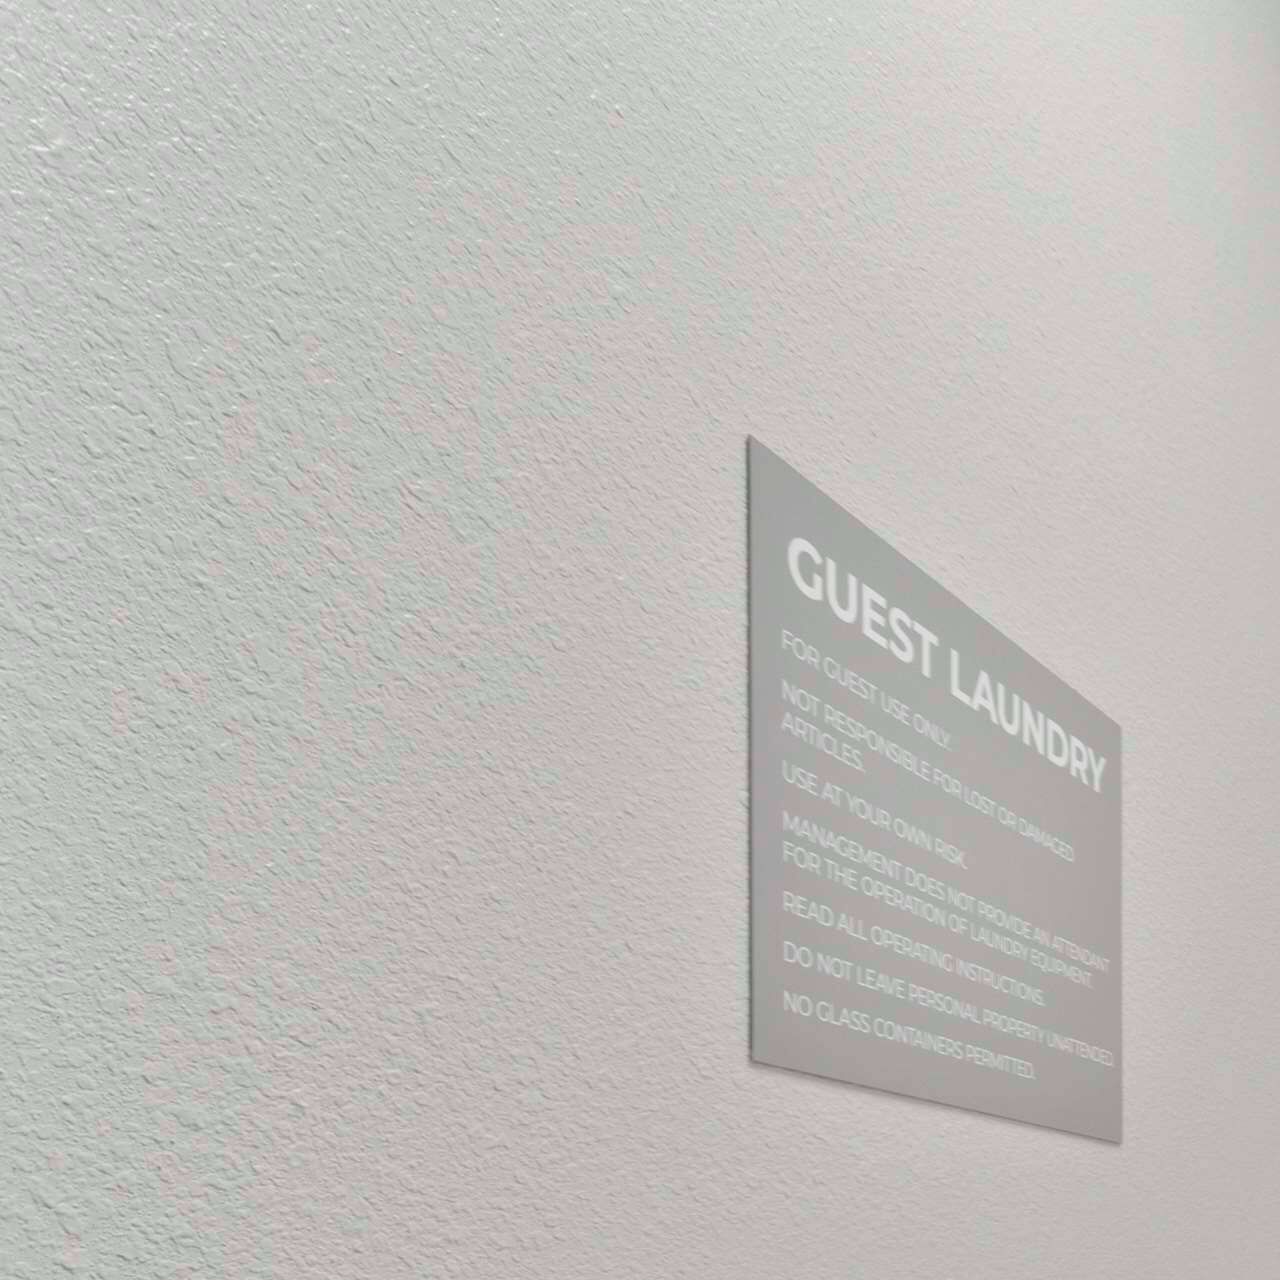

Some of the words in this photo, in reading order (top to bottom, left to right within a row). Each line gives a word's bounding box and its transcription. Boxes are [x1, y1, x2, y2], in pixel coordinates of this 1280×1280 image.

[780, 627, 820, 671] FOR
[822, 654, 879, 707] GUEST
[879, 690, 912, 727] USE
[786, 537, 939, 679] GUEST
[949, 647, 1107, 794] LAUNDRY
[780, 676, 822, 720] NOT
[823, 702, 931, 782] RESPONSIBLE
[932, 766, 963, 800] FOR
[963, 784, 996, 819] LOST
[998, 805, 1017, 831] OR
[781, 759, 818, 796] USE
[822, 779, 843, 808] AT
[842, 790, 892, 832] YOUR
[893, 816, 933, 852] OWN
[782, 809, 904, 882] MANAGEMENT
[905, 866, 945, 901] DOES
[947, 886, 975, 914] NOT
[977, 900, 1032, 940] PROVIDE
[1032, 925, 1050, 947] AN
[782, 840, 822, 876] FOR
[823, 858, 859, 891] THE
[860, 874, 945, 927] OPERATION
[947, 913, 968, 937] OF
[969, 922, 1031, 963] LAUNDRY
[782, 890, 834, 928] READ
[836, 911, 868, 941] ALL
[870, 925, 954, 973] OPERATING
[782, 941, 815, 970] DO
[816, 952, 853, 982] NOT
[855, 966, 905, 999] LEAVE
[908, 984, 981, 1023] PERSONAL
[982, 1009, 1045, 1044] PROPERTY
[783, 990, 814, 1018] NO
[815, 999, 871, 1034] GLASS
[873, 1017, 964, 1059] CONTAINERS
